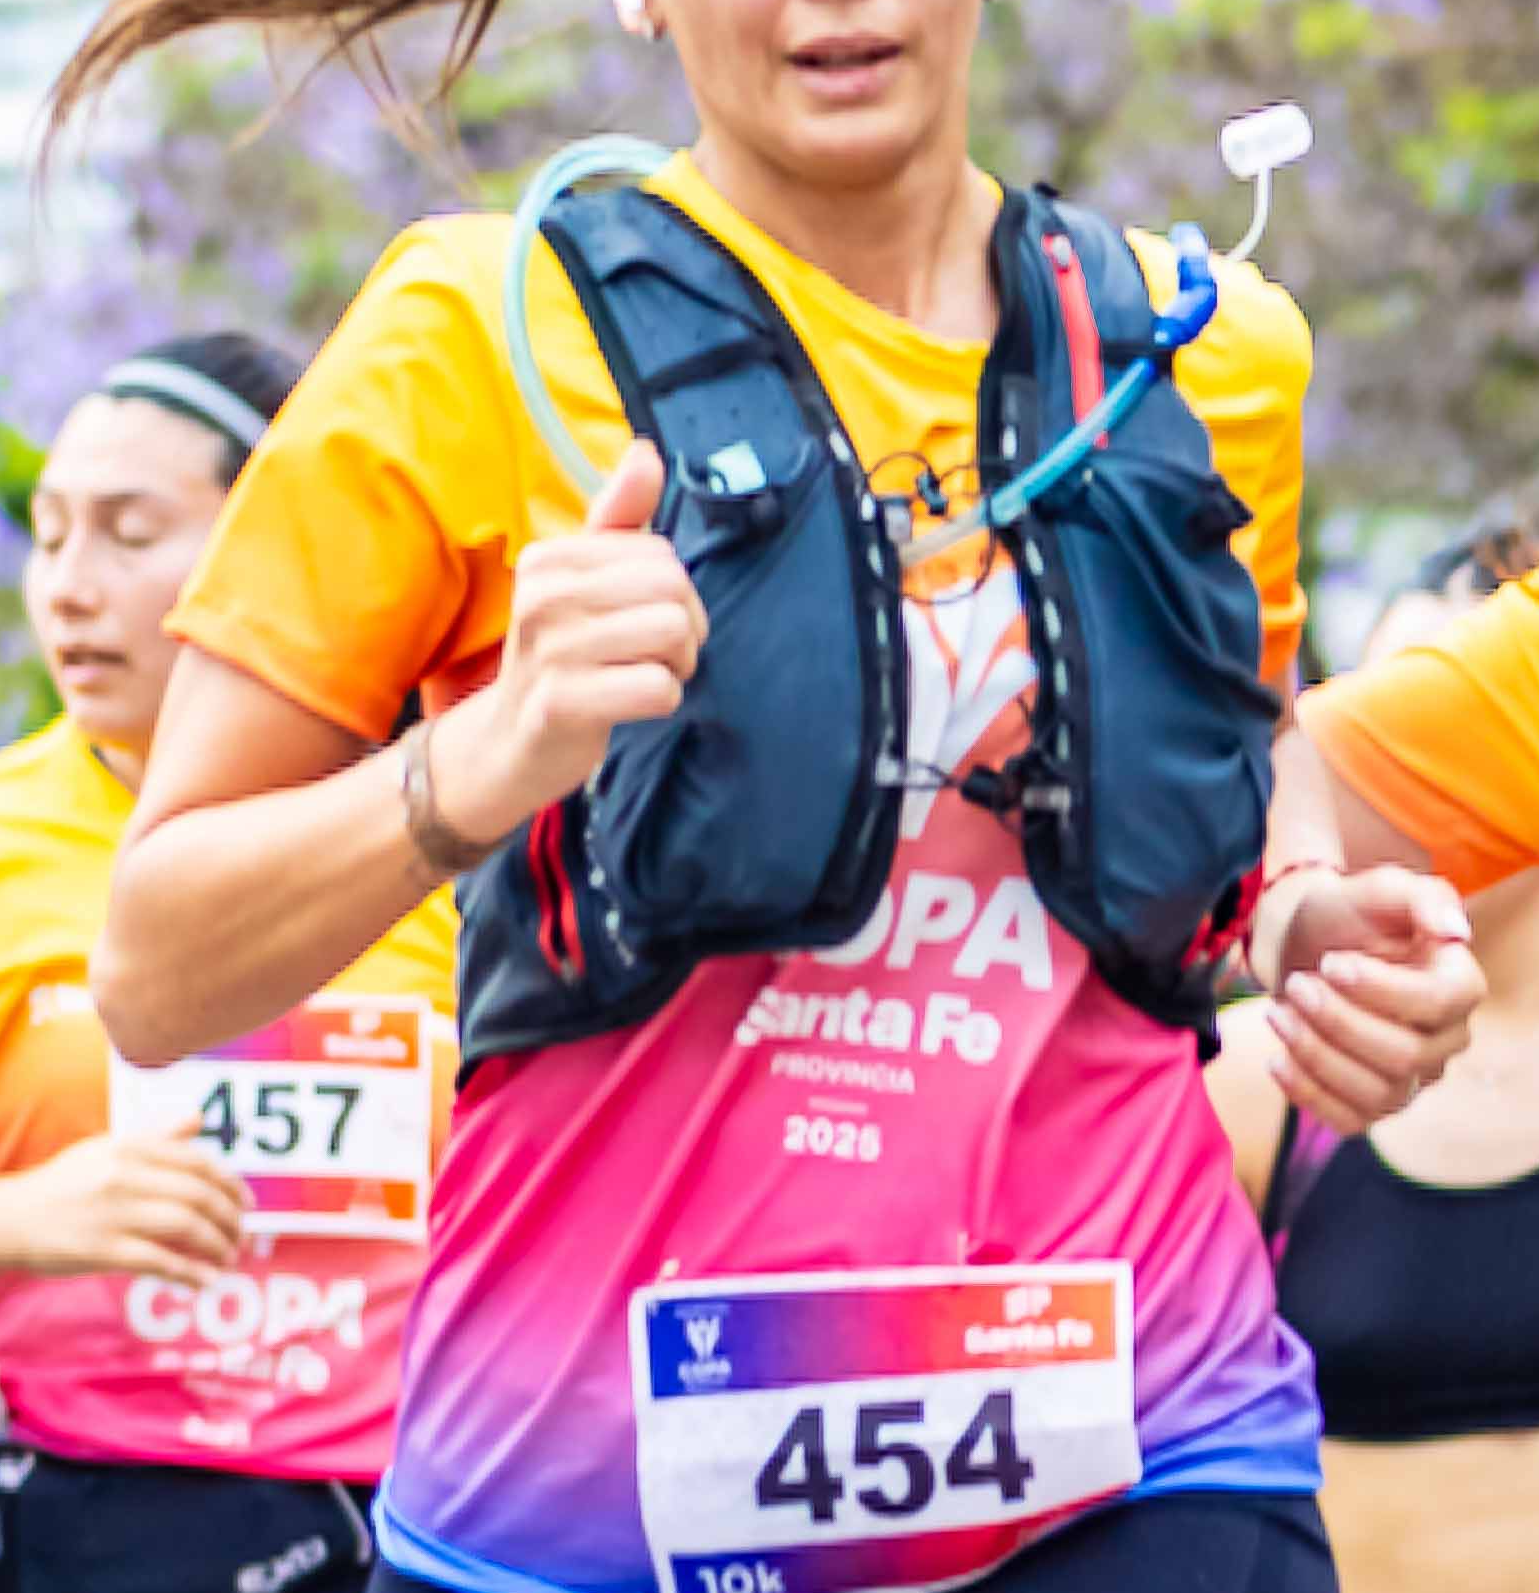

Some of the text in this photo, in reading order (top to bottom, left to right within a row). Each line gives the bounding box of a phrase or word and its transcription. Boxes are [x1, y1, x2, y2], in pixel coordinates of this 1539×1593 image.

[736, 985, 1002, 1064] Santa Fe
[771, 1052, 915, 1093] PROVINCIA
[196, 1079, 362, 1155] 457
[127, 1273, 366, 1348] COPA
[755, 1388, 1033, 1524] 454
